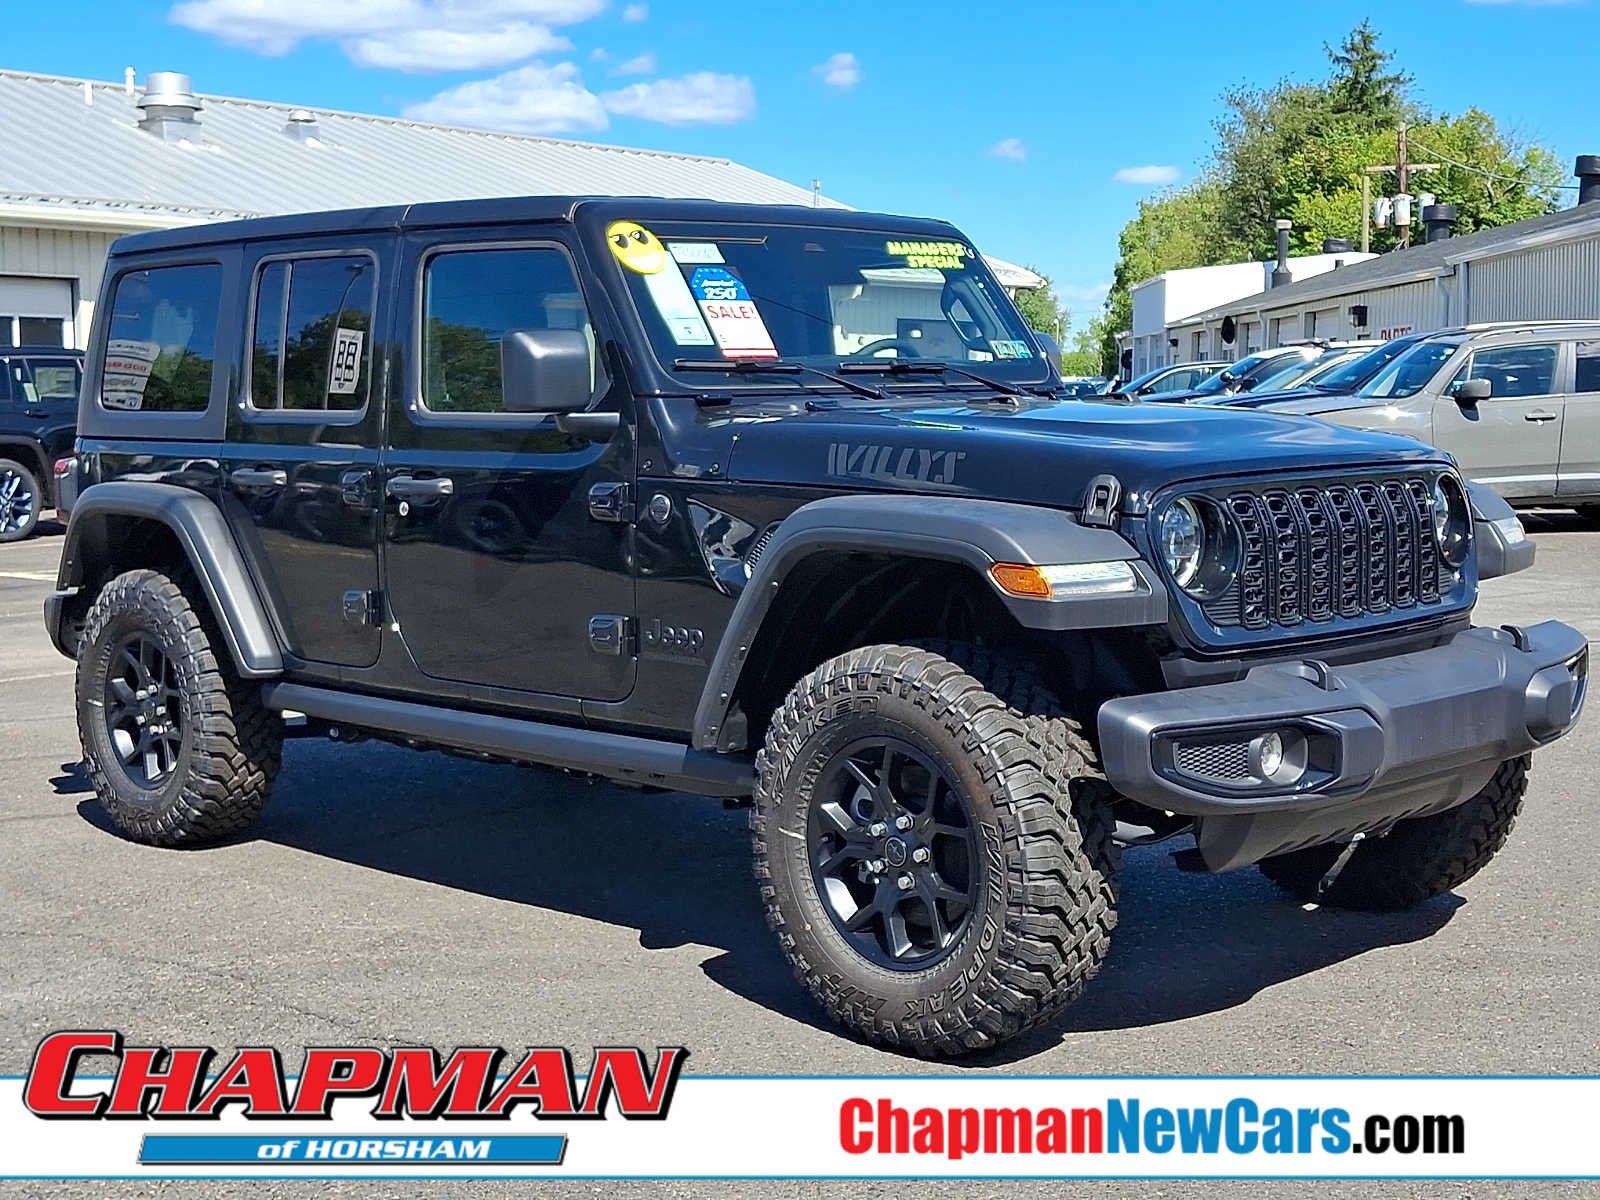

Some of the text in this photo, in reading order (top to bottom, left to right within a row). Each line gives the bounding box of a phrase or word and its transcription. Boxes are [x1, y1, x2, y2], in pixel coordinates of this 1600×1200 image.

[906, 255, 965, 269] SPECIAL
[706, 305, 757, 319] SALE!
[827, 443, 967, 484] WILLYS
[644, 617, 704, 655] Jeep
